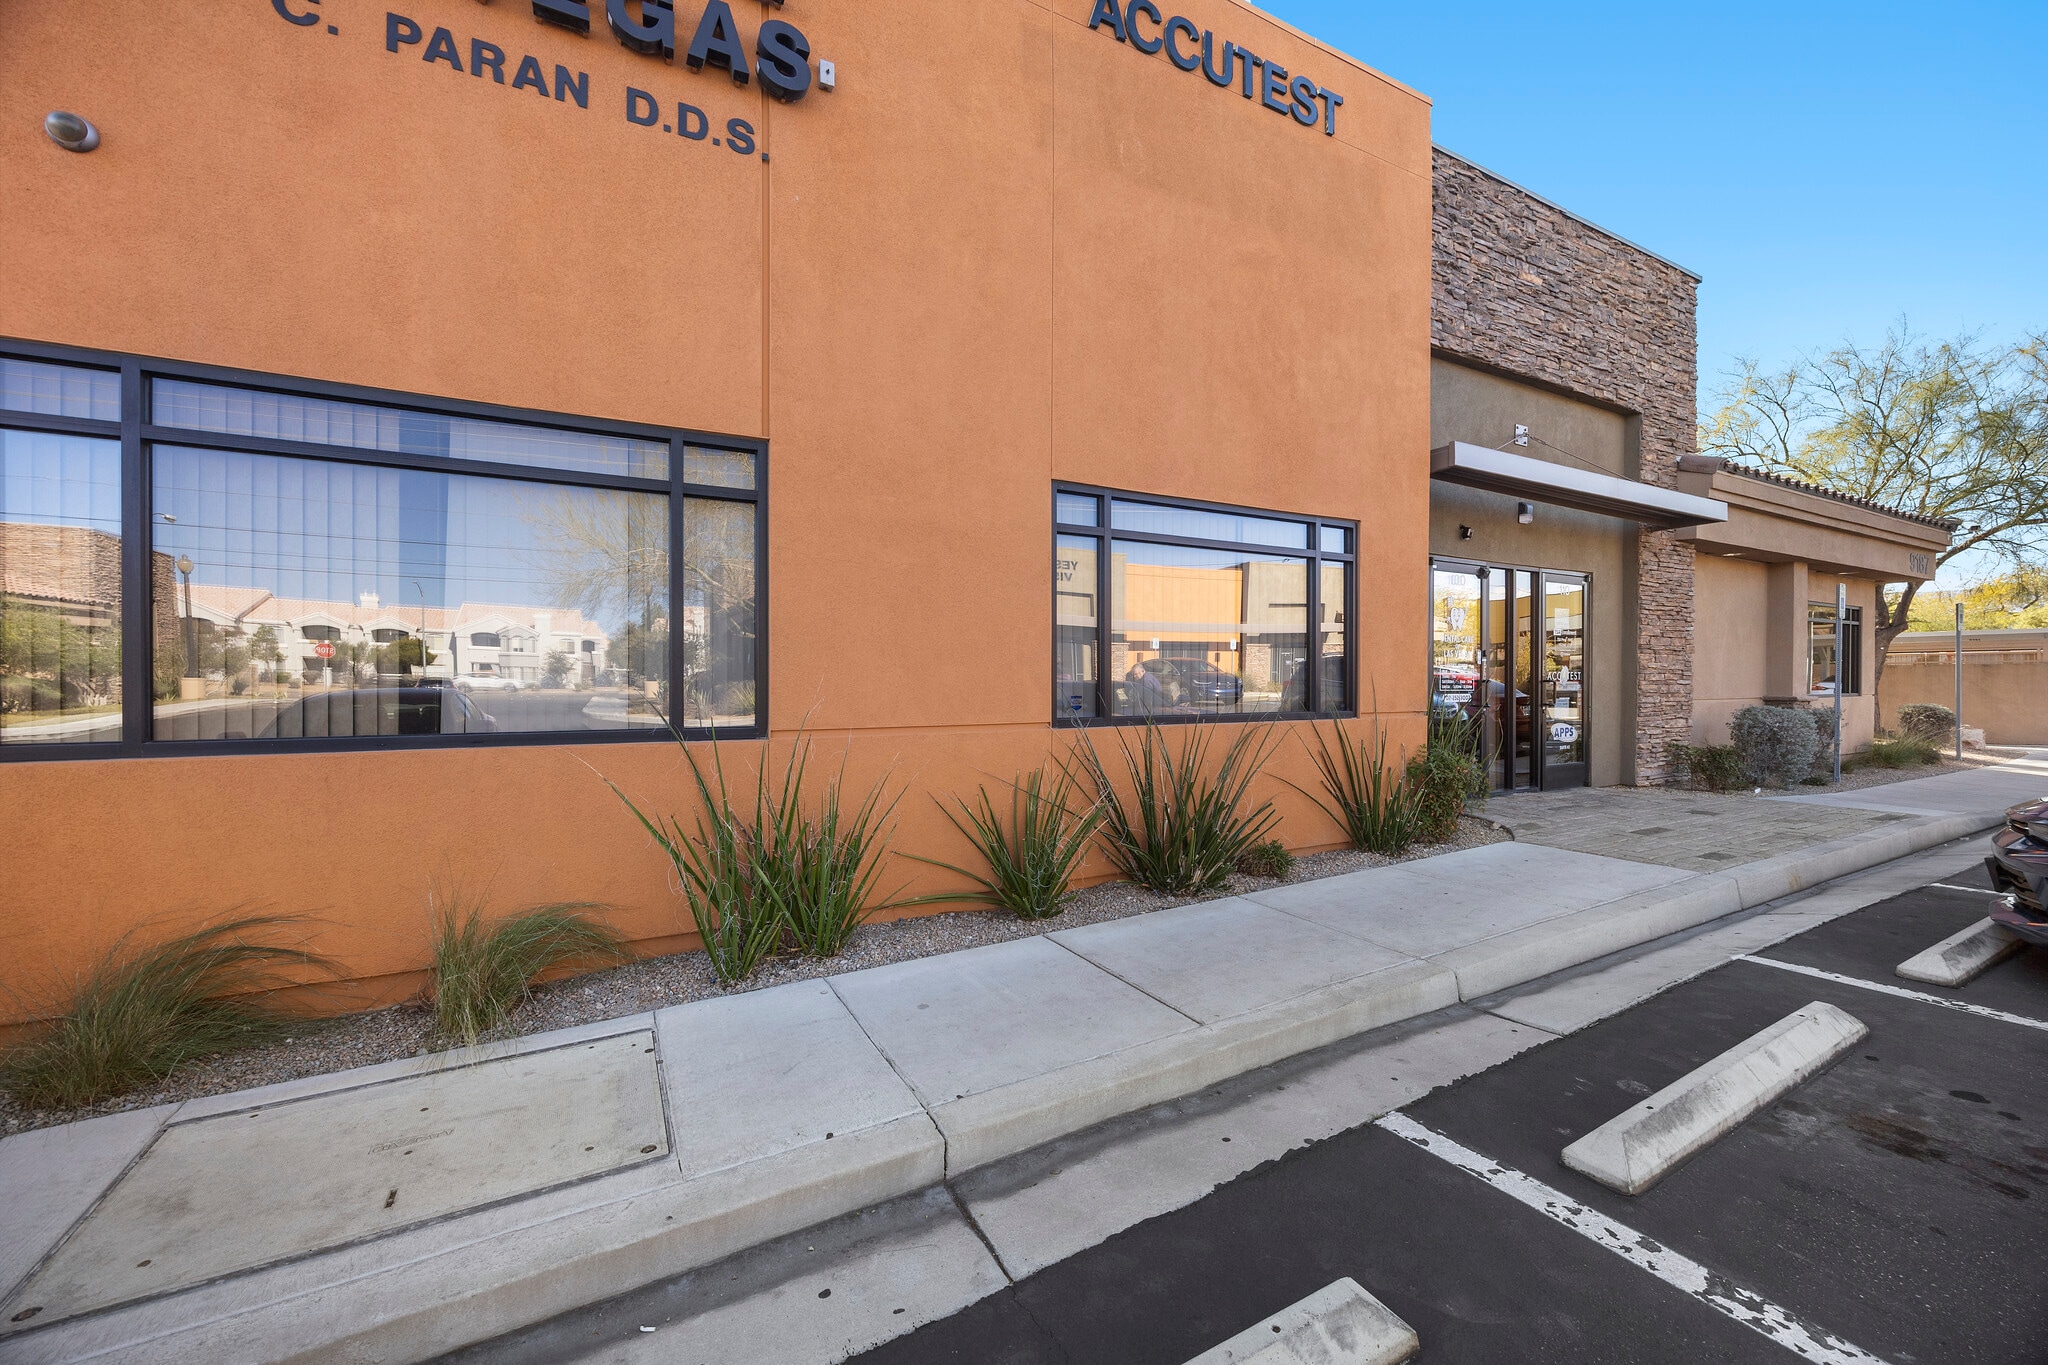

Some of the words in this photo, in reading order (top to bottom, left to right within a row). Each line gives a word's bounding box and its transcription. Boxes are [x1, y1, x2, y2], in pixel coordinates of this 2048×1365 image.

[1088, 0, 1344, 137] ACCUTEST
[386, 12, 589, 109] PARAN
[626, 86, 770, 162] D.D.S.
[1909, 552, 1929, 575] 9187
[1547, 671, 1582, 681] ACCTEST
[1554, 727, 1574, 738] APPS
